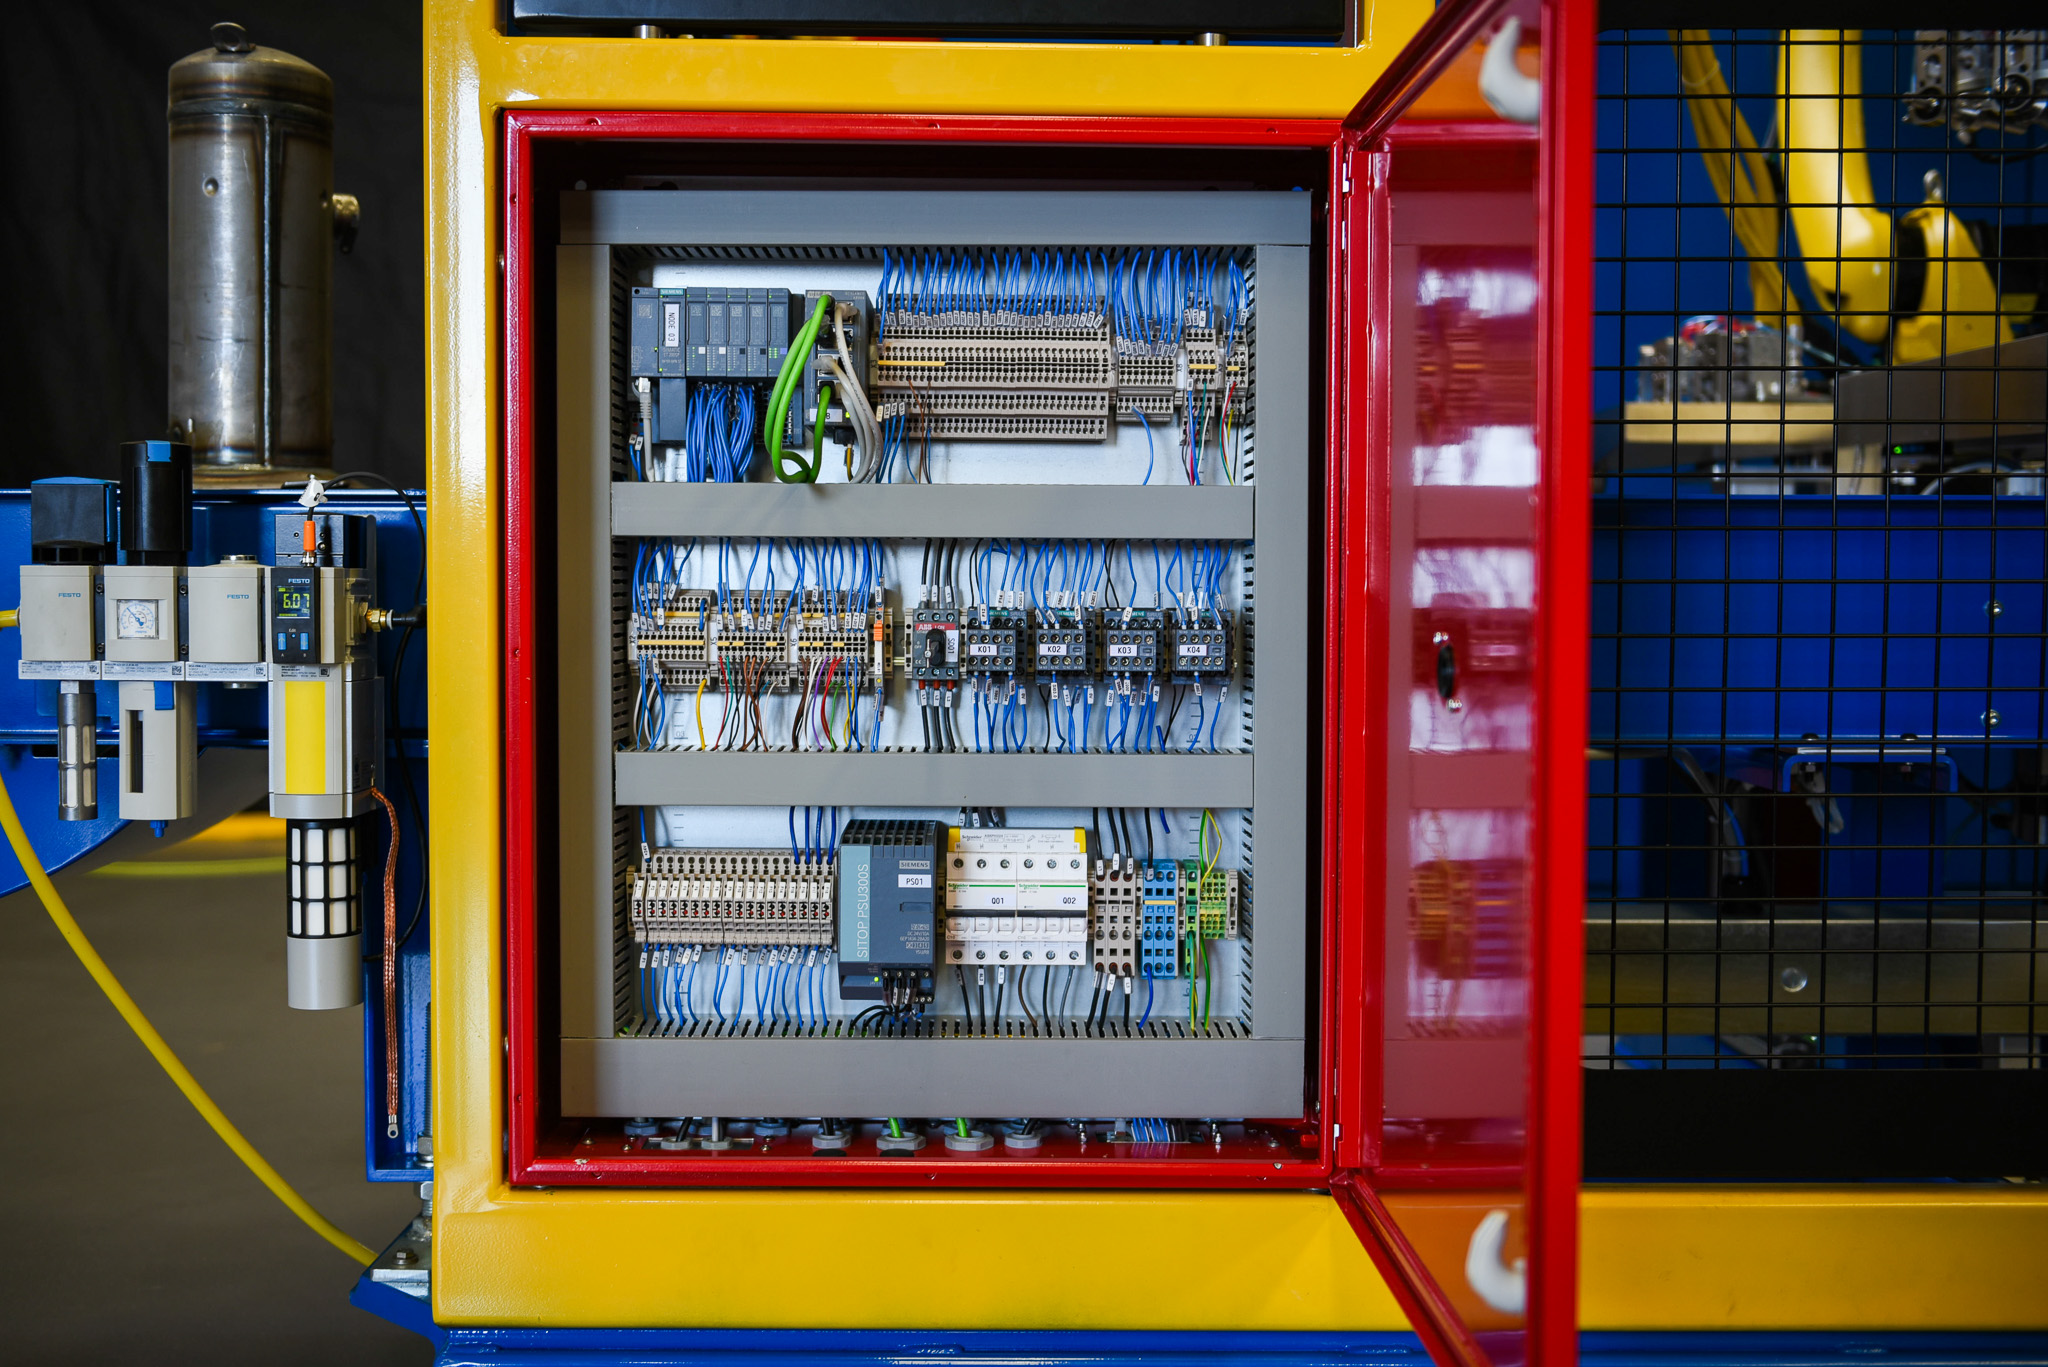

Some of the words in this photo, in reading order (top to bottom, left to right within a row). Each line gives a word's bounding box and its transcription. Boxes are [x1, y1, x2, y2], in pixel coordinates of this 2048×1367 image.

[1177, 364, 1182, 372] X8
[283, 594, 310, 608] 6.07
[629, 636, 636, 644] X2
[791, 638, 797, 646] X6
[857, 864, 868, 917] PSU300S
[857, 921, 867, 958] SITOP
